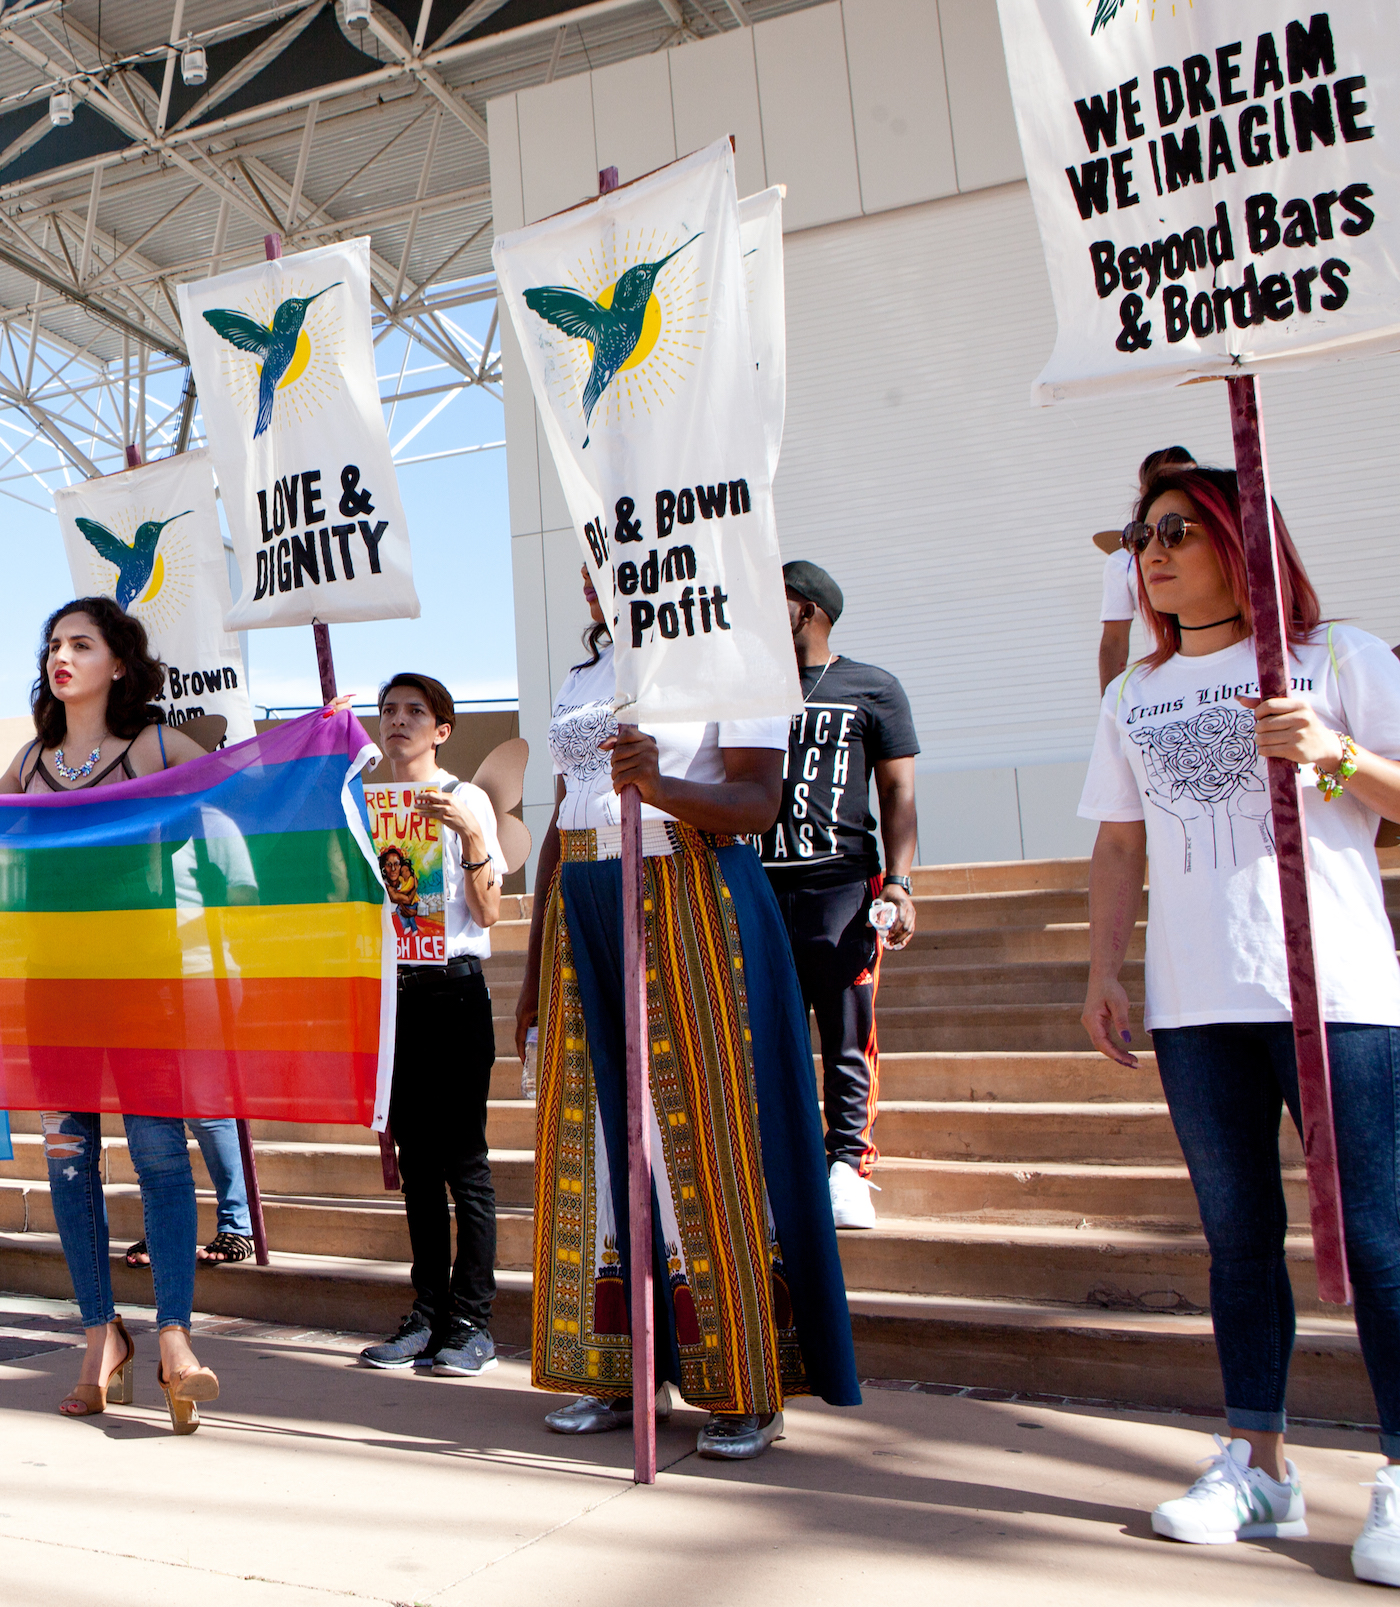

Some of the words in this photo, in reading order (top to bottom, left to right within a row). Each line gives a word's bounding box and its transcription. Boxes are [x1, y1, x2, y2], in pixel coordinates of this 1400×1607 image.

[1074, 76, 1145, 154] WE
[1153, 12, 1337, 128] DREAM
[1065, 146, 1140, 221] WE
[1148, 75, 1376, 197] IMAGINE
[1088, 201, 1236, 300] Beyond
[1245, 182, 1376, 256] Bars
[1115, 292, 1153, 353] &
[1162, 257, 1352, 344] Borders
[256, 469, 326, 544] LOVE
[338, 464, 376, 518] &
[614, 495, 644, 545] &
[252, 520, 390, 602] DIGNITY
[613, 543, 698, 599] edm
[168, 666, 238, 700] Brown
[1126, 696, 1186, 725] Trans
[371, 811, 439, 843] UTURE
[415, 935, 445, 960] ICE
